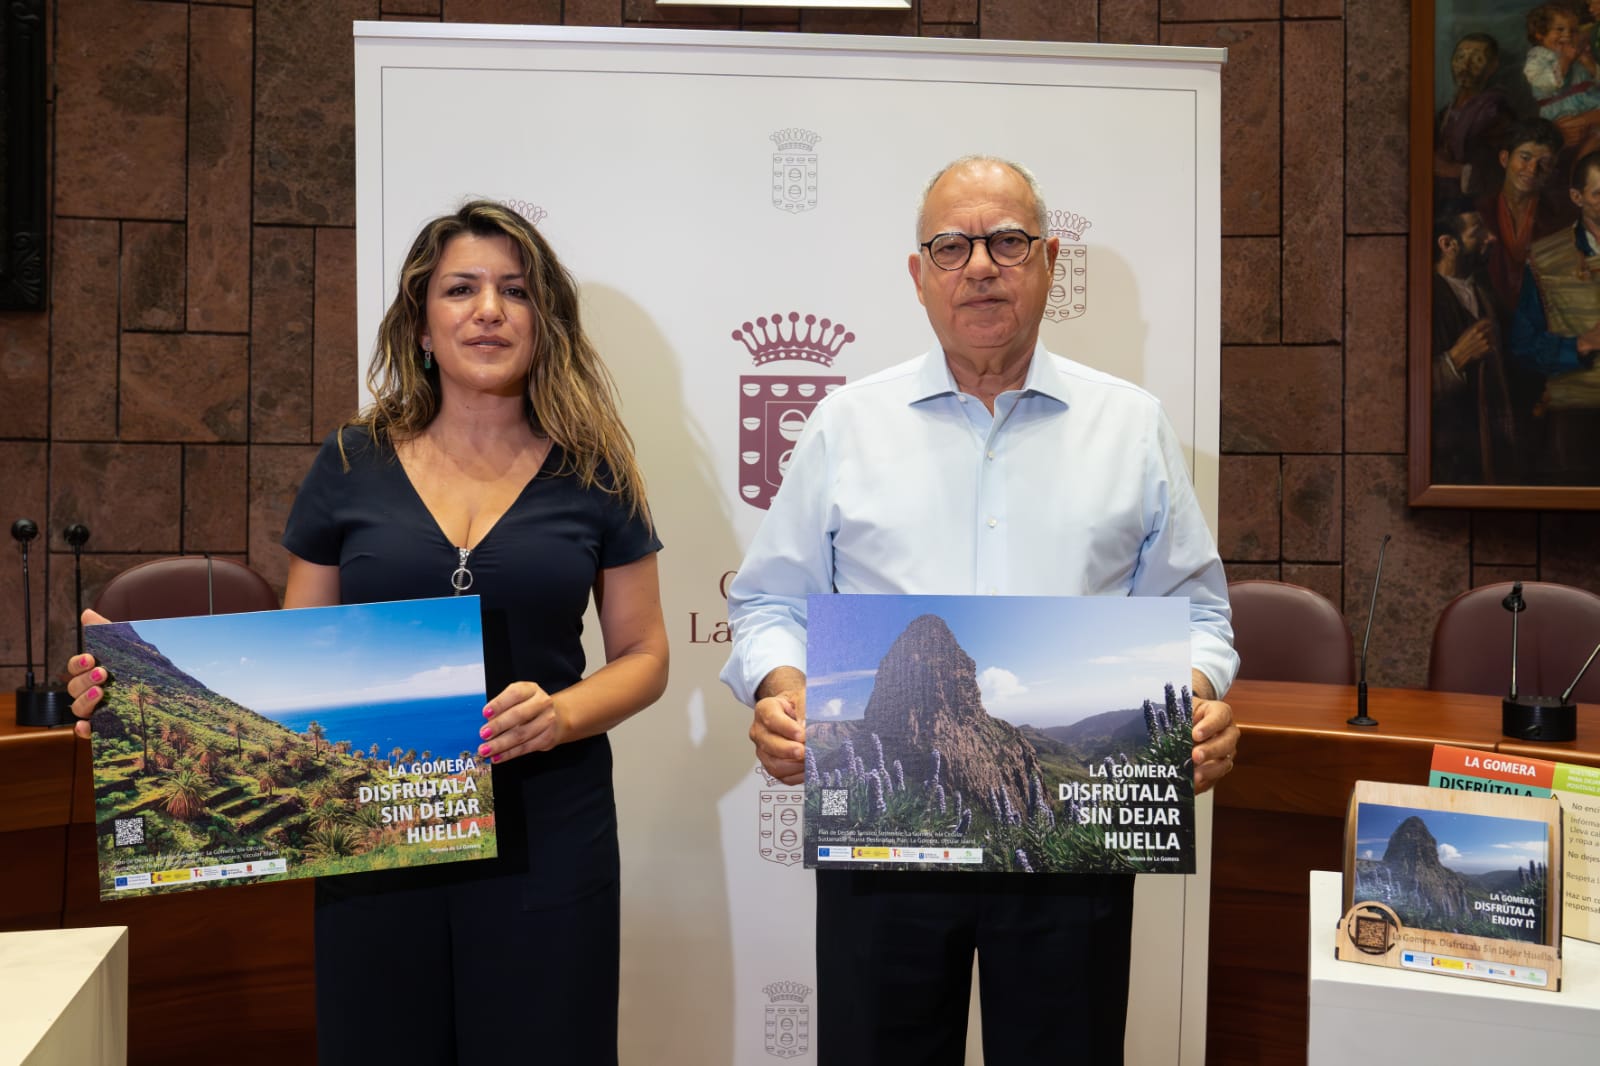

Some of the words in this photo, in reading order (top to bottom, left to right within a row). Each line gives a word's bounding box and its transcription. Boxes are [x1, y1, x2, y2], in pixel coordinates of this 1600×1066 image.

[688, 611, 733, 644] La
[388, 765, 407, 778] LA
[411, 758, 476, 775] GOMERA
[1089, 764, 1108, 778] LA
[1112, 764, 1178, 778] GOMERA
[1464, 755, 1480, 769] LA
[1482, 758, 1536, 777] GOMERA
[359, 776, 477, 803] DISFRÚTALA
[1058, 778, 1179, 802] DISFRÚTALA
[381, 805, 413, 823] SIN
[420, 798, 480, 819] DEJAR
[1079, 807, 1112, 825] SIN
[1119, 807, 1181, 825] DEJAR
[407, 821, 481, 844] HUELLA
[1105, 832, 1181, 850] HUELLA
[1474, 901, 1536, 918] DISFRÚTALA
[1489, 893, 1500, 901] LA
[1501, 894, 1536, 906] GOMERA
[1491, 914, 1524, 928] ENJOY
[1525, 919, 1536, 929] IT
